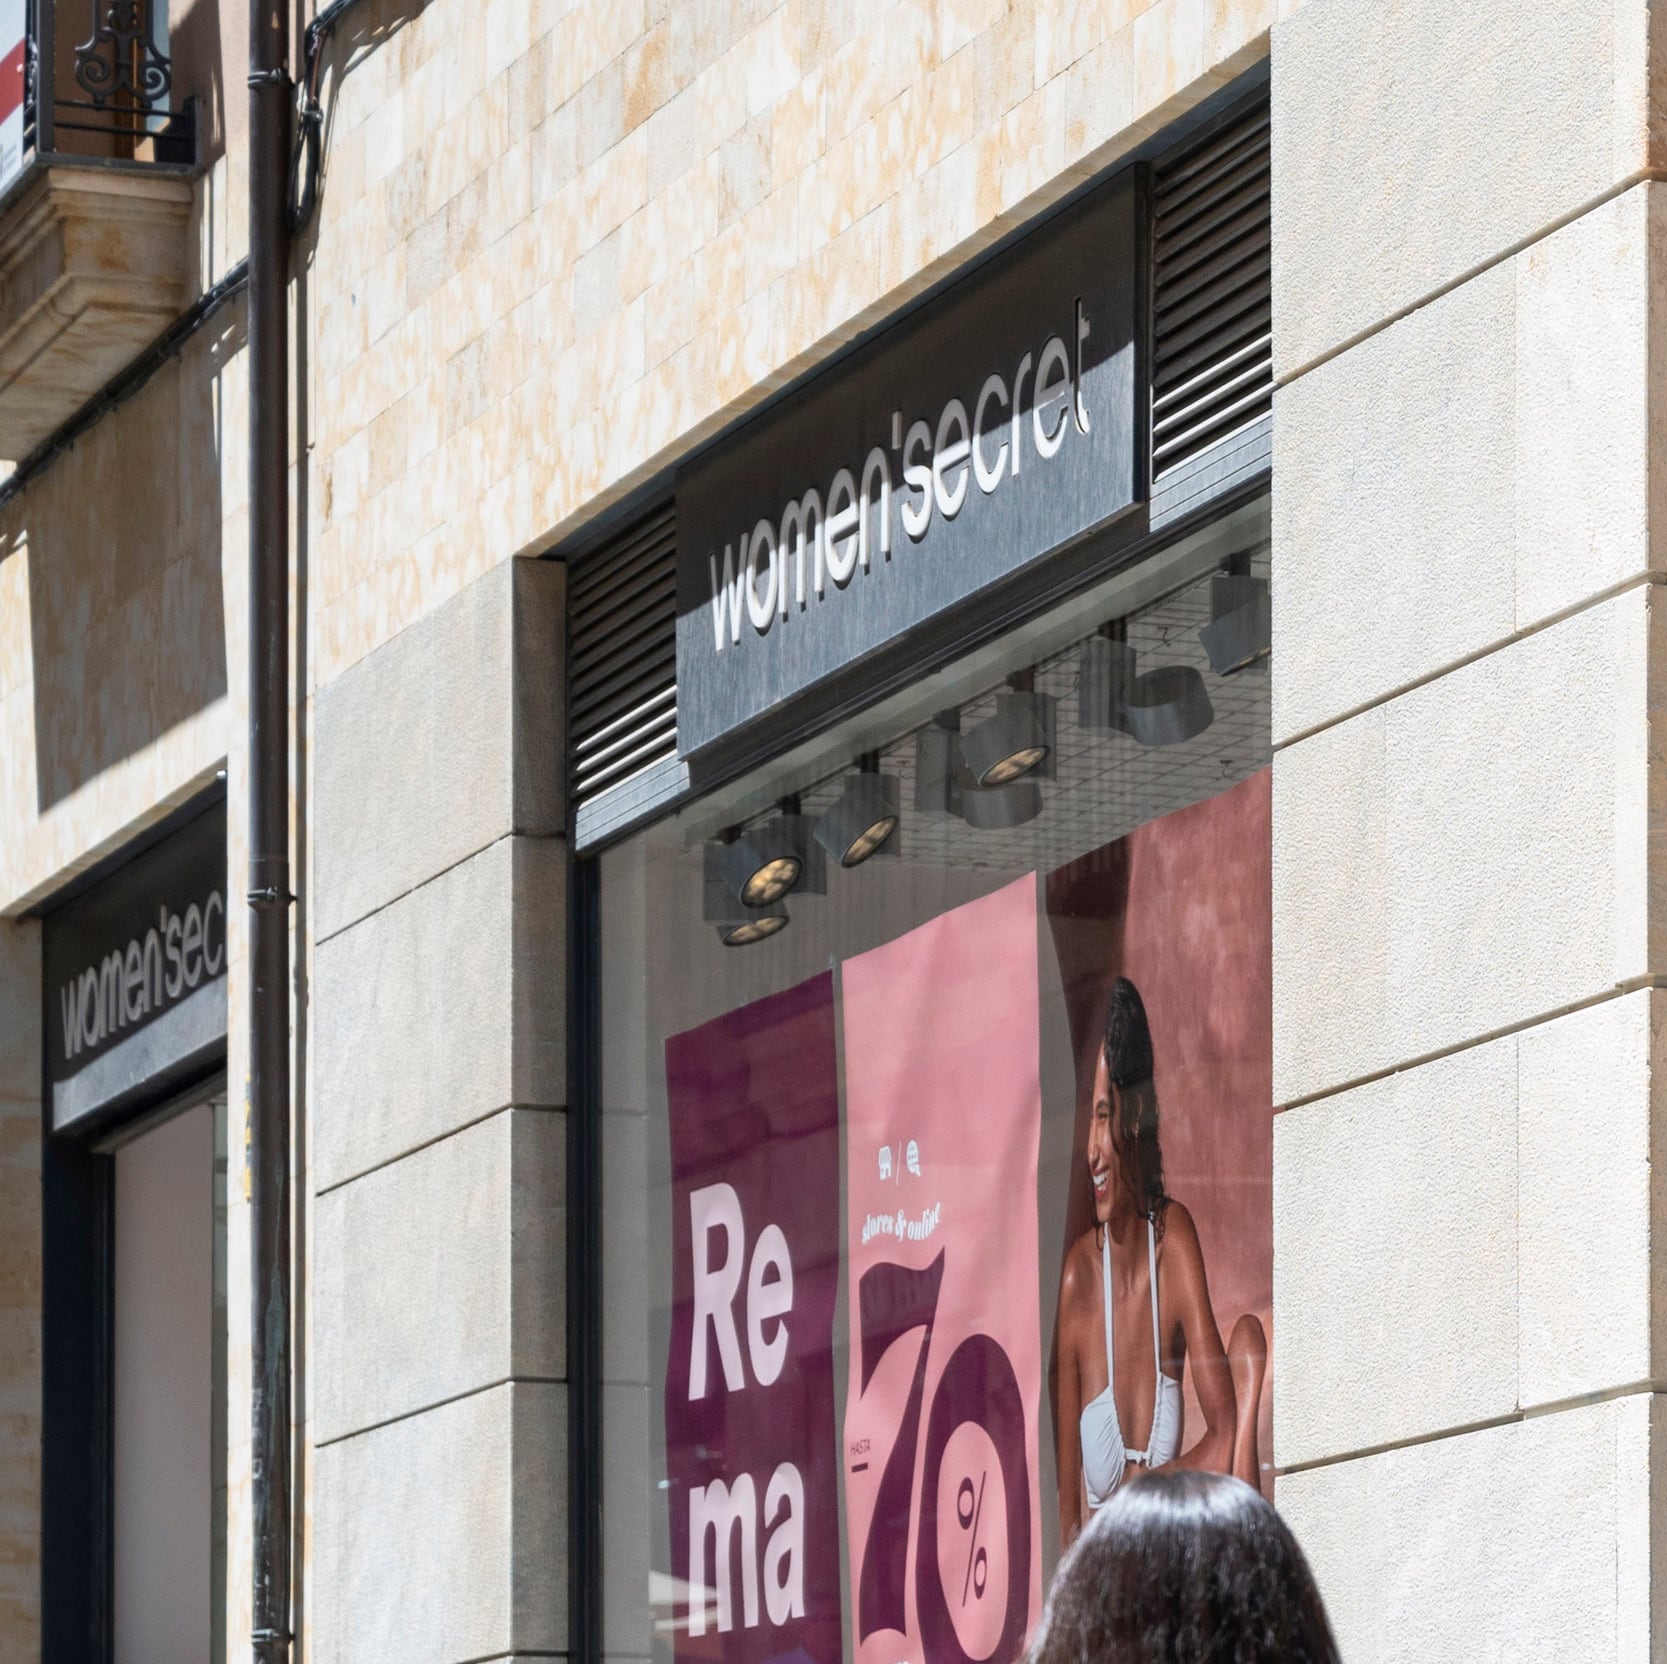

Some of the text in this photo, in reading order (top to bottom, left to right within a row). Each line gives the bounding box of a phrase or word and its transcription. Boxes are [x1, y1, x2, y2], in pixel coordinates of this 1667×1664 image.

[709, 297, 1093, 652] women'secret
[688, 1181, 795, 1402] Re
[688, 1460, 806, 1638] ma
